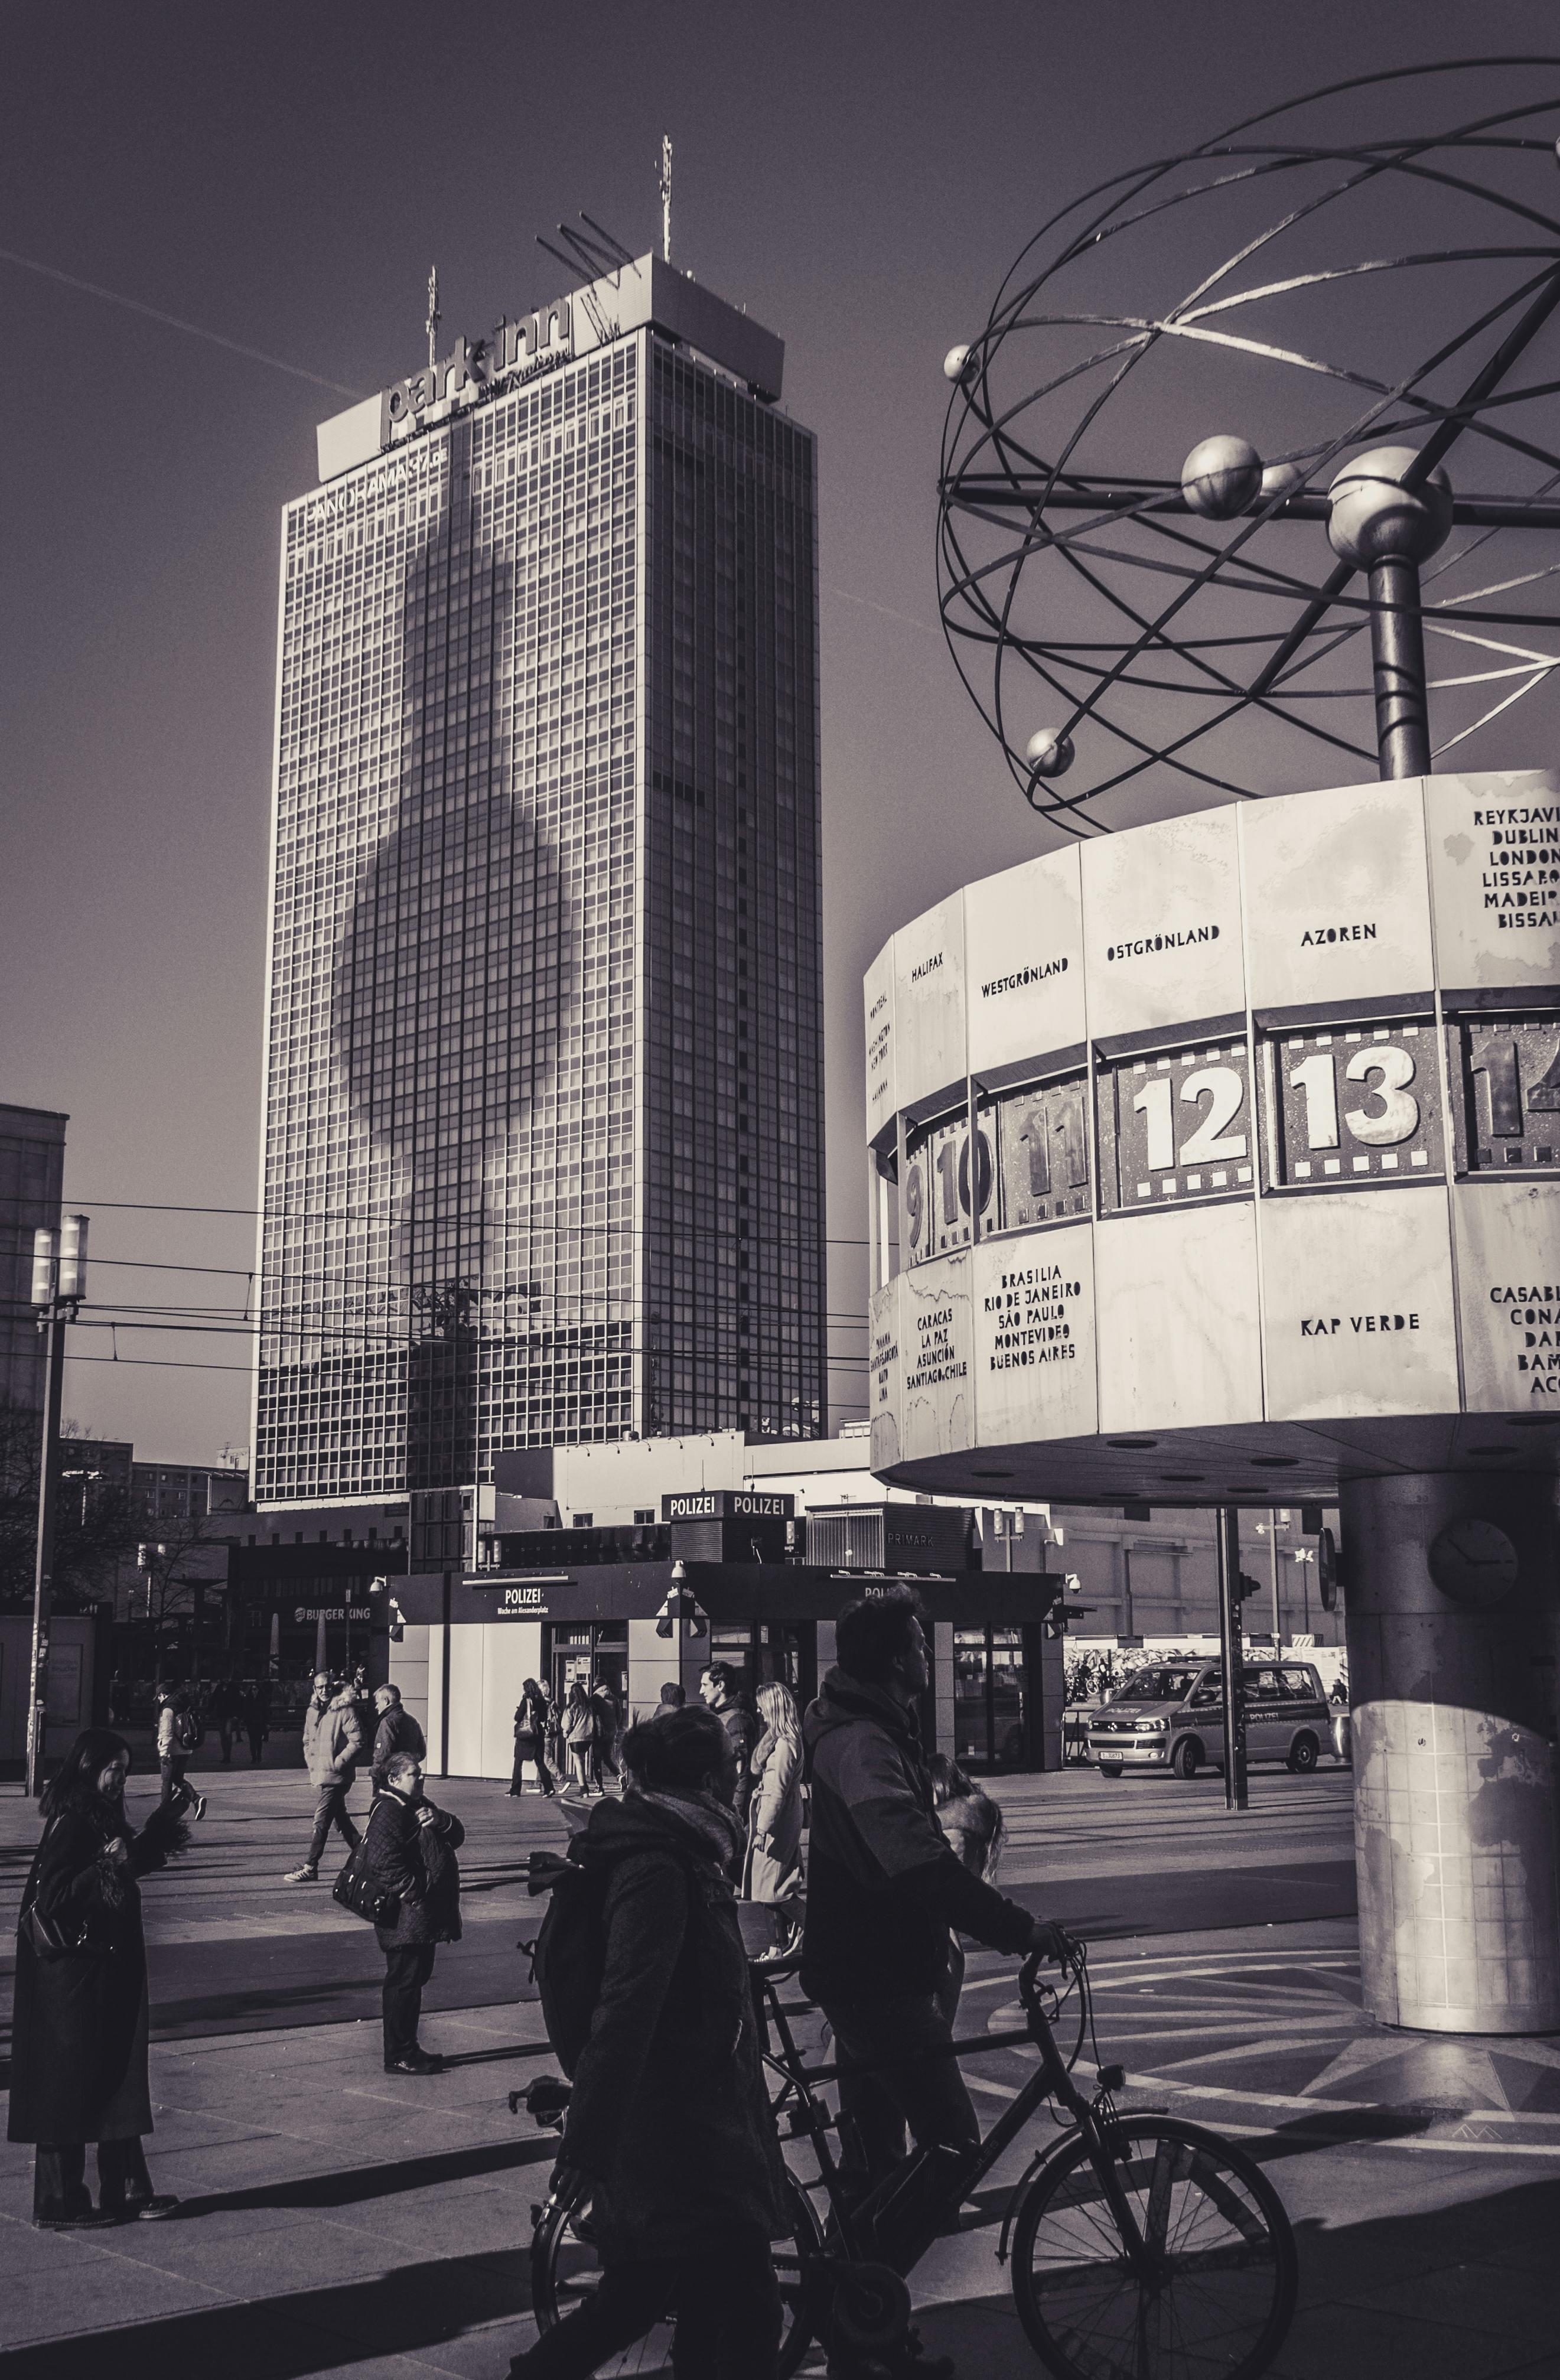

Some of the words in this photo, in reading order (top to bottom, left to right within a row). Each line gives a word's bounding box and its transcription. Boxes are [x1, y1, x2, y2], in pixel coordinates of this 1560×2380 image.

[380, 335, 486, 450] park
[494, 297, 571, 372] inn
[1492, 828, 1559, 845] DUBLIN
[1490, 848, 1560, 866] LONDON
[1107, 925, 1220, 962] OSTGRÖNLAND
[1301, 923, 1377, 947] AZOREN
[911, 952, 943, 983] HALIFAX
[981, 957, 1069, 998] WESTGRÖNLAND
[1289, 1046, 1420, 1151] 13
[1133, 1067, 1247, 1171] 12
[1019, 1096, 1089, 1196] 11
[937, 1129, 994, 1225] 10
[906, 1164, 924, 1249] 9
[1001, 1265, 1061, 1289] BRASILIA
[984, 1295, 1002, 1312] RIO
[1006, 1291, 1020, 1308] DE
[1025, 1281, 1081, 1304] JANEIRO
[917, 1308, 952, 1331] CARACAS
[999, 1310, 1020, 1329] SÃO
[1027, 1304, 1064, 1324] PAULO
[1301, 1318, 1341, 1336] KAP
[1350, 1314, 1419, 1333] VERDE
[921, 1333, 931, 1349] LA
[934, 1328, 948, 1345] PAZ
[995, 1324, 1070, 1350] MONTEVIDEO
[917, 1343, 955, 1369] ASUNCIÓN
[990, 1350, 1034, 1370] BUENOS
[1038, 1344, 1075, 1363] AIRES
[907, 1368, 942, 1389] SANTIAGO
[945, 1361, 967, 1380] CHILE
[670, 1496, 715, 1516] POLIZEI
[734, 1496, 784, 1515] POLIZEI
[888, 1533, 934, 1546] PRIMARK
[505, 1588, 540, 1604] POLIZEI
[1250, 1712, 1279, 1722] POLIZEI
